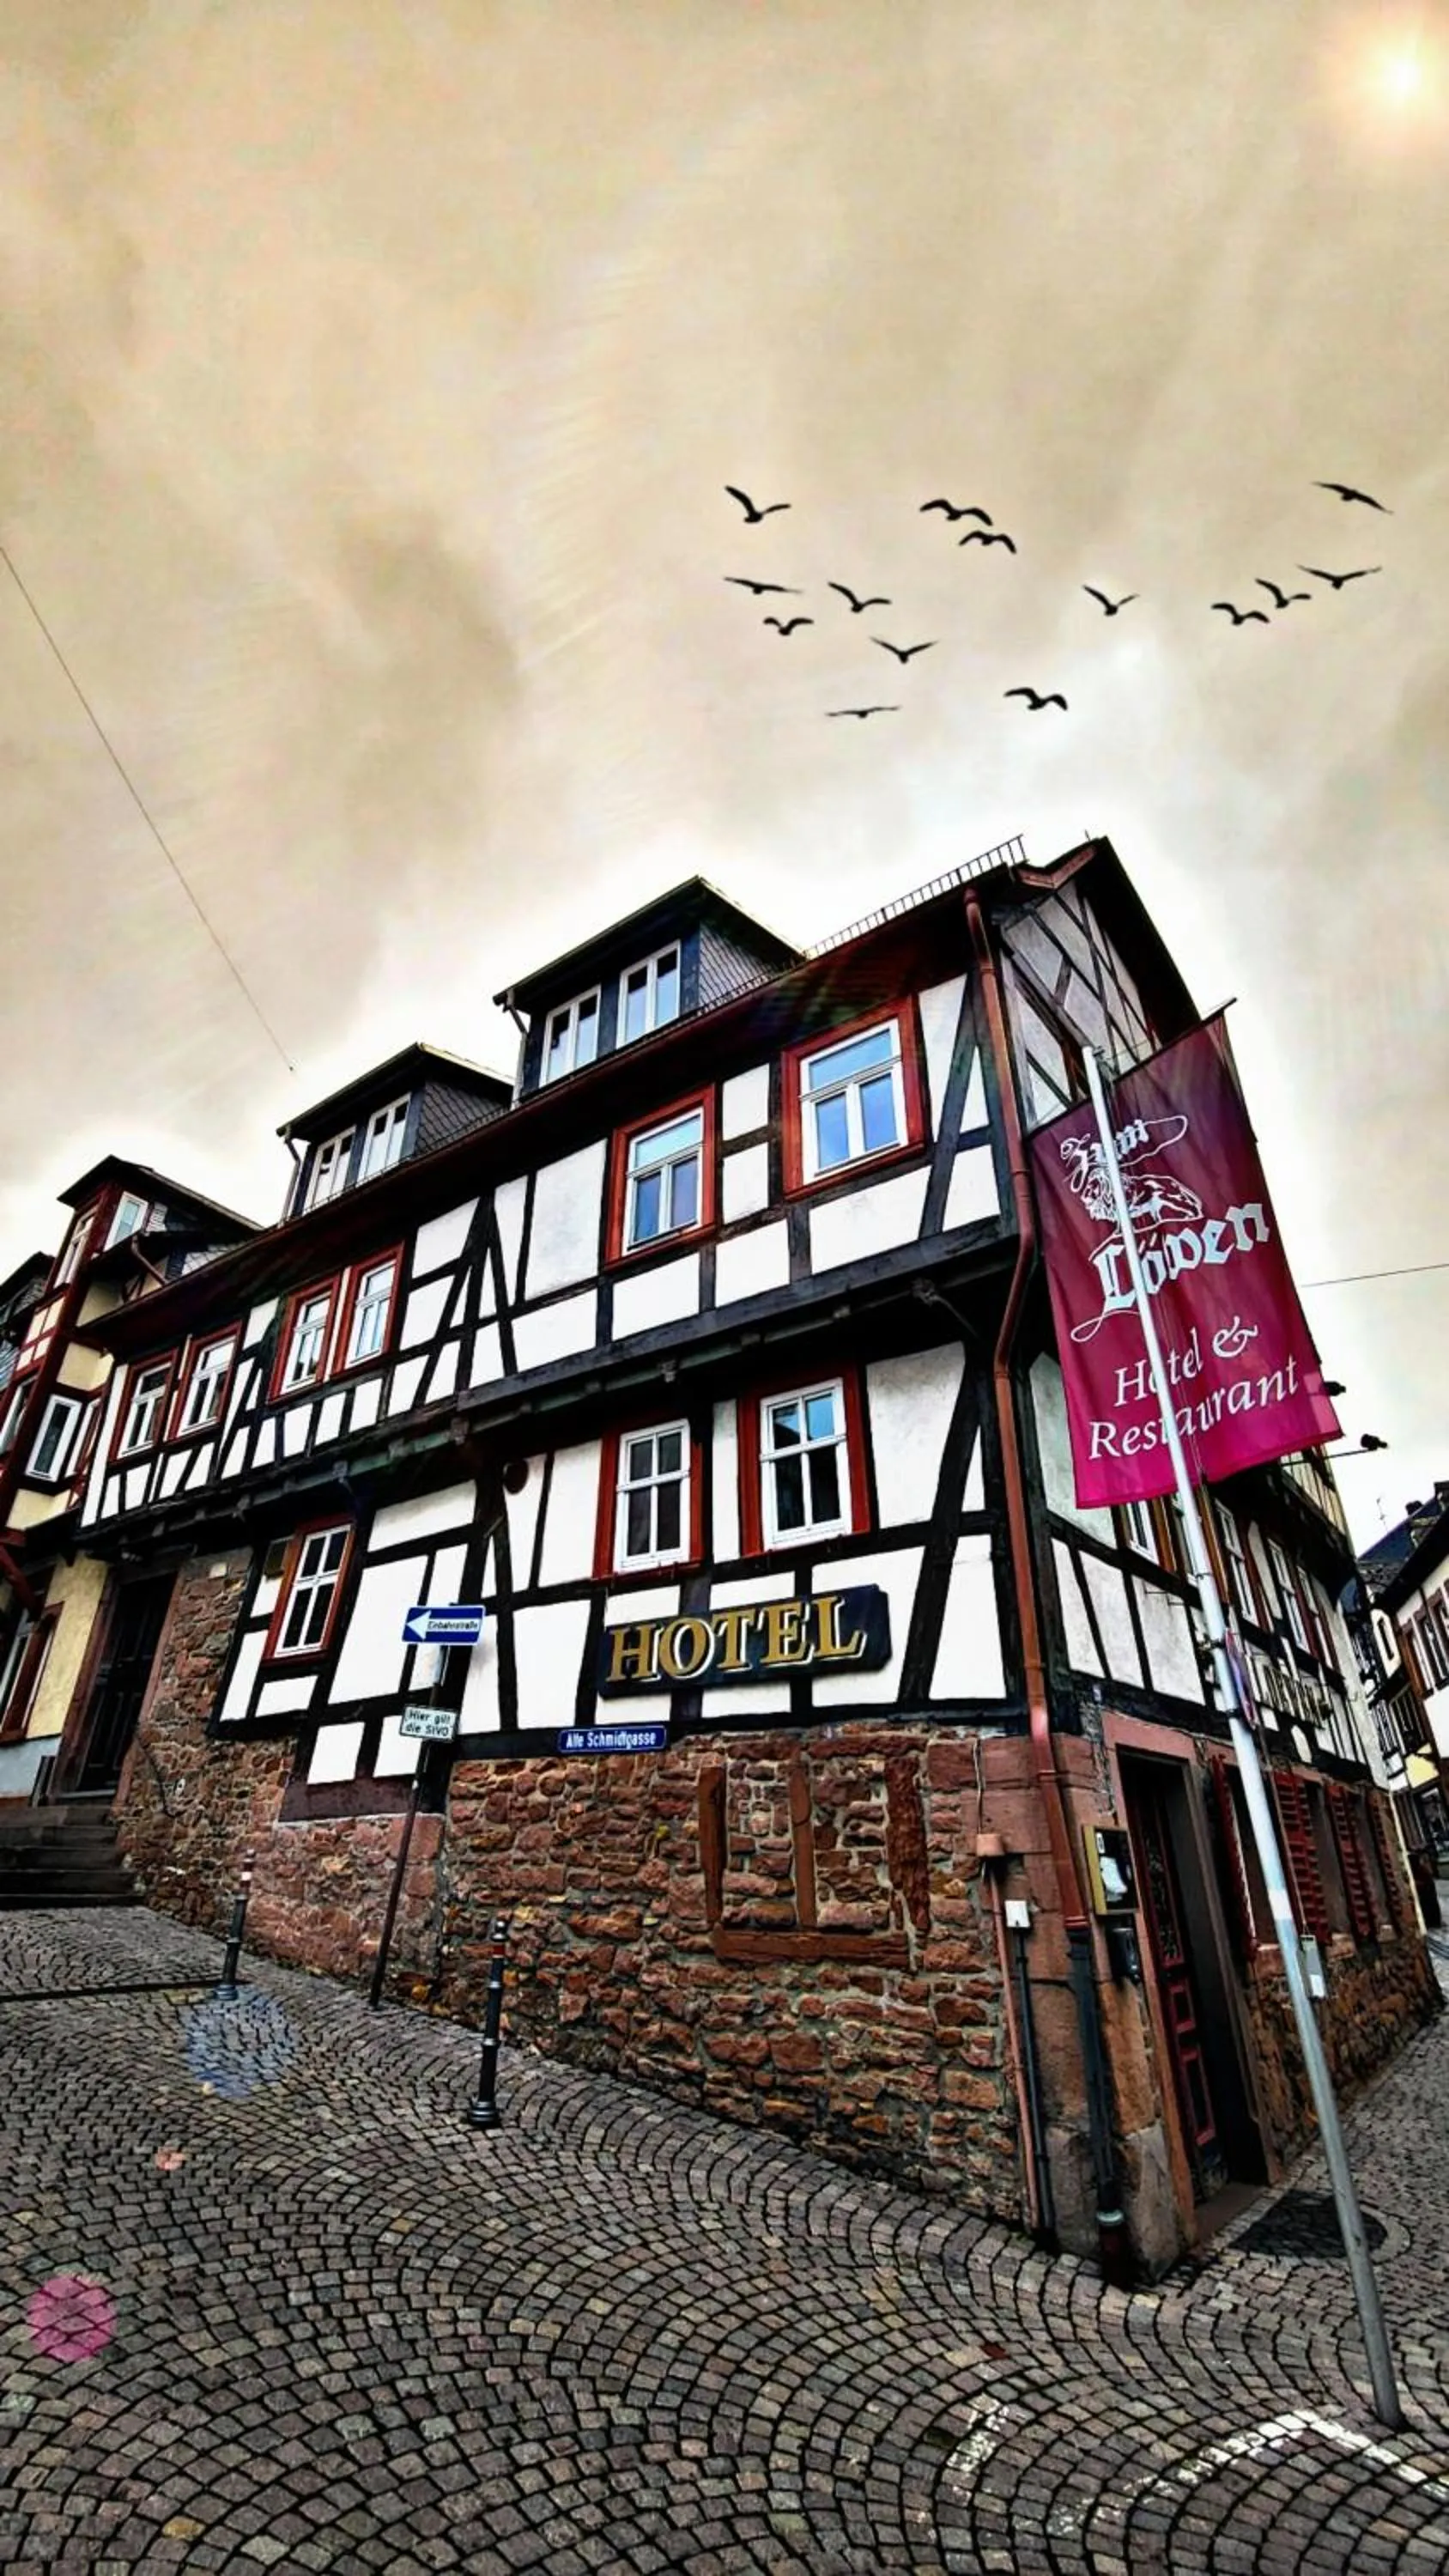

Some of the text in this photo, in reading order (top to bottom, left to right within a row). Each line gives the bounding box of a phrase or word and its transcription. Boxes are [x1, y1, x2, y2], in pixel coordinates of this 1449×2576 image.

[1091, 1203, 1270, 1312] Löwen
[1212, 1315, 1259, 1358] &
[605, 1595, 867, 1683] HOTEL
[404, 1722, 421, 1734] die
[405, 1709, 431, 1722] Hier
[566, 1730, 657, 1750] Alte Schmidtgasse
